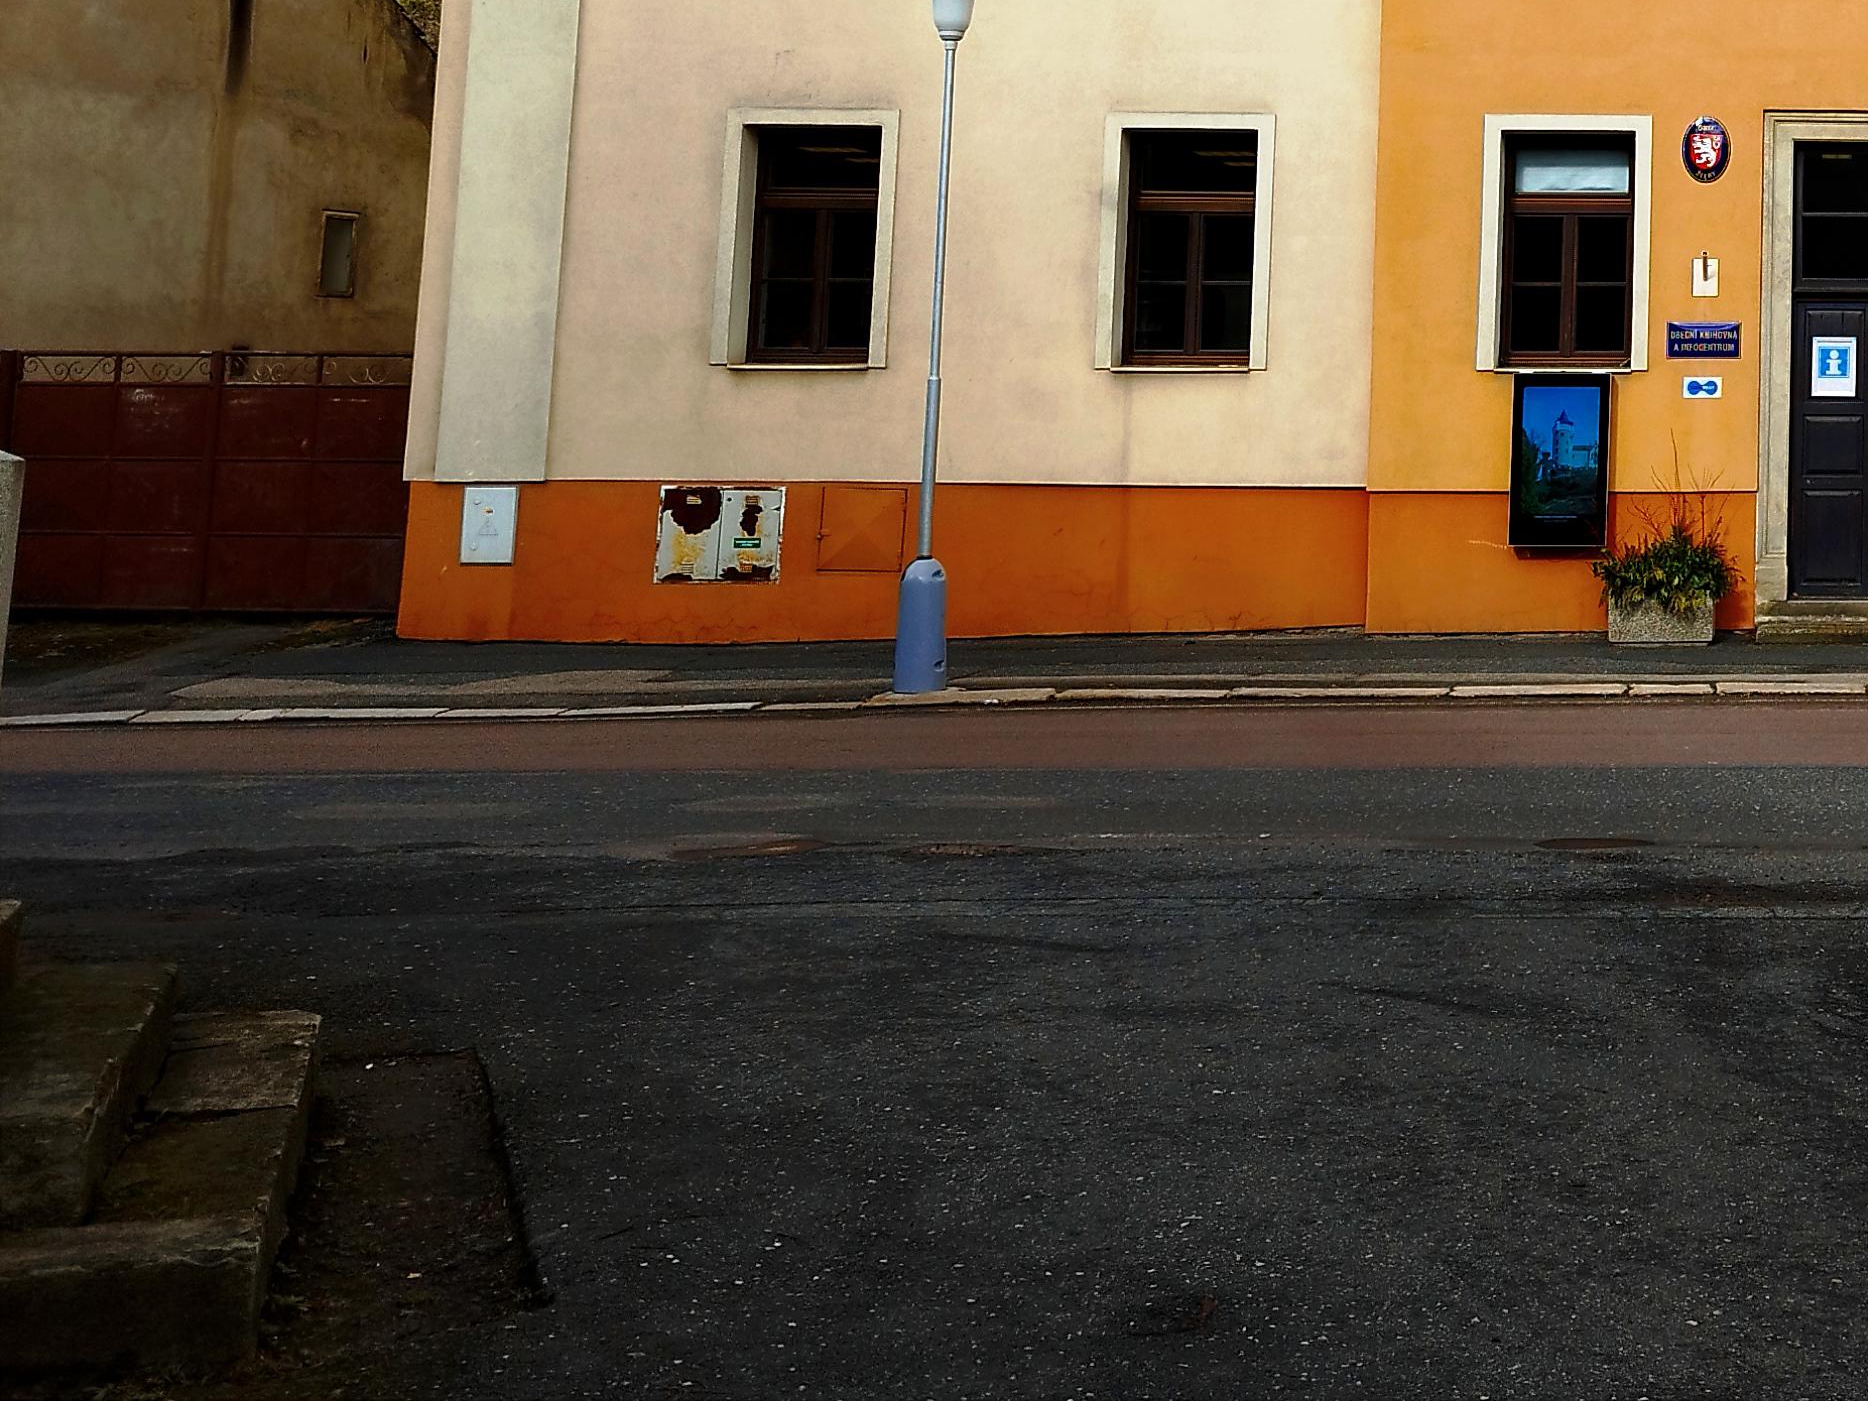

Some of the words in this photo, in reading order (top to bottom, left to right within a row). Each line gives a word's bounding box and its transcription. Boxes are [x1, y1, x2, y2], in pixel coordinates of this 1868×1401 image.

[1670, 328, 1697, 340] OBECNÍ
[1699, 330, 1738, 340] KNIHOVNA
[1673, 343, 1679, 352] A
[1681, 343, 1735, 352] INFOCENTRUM
